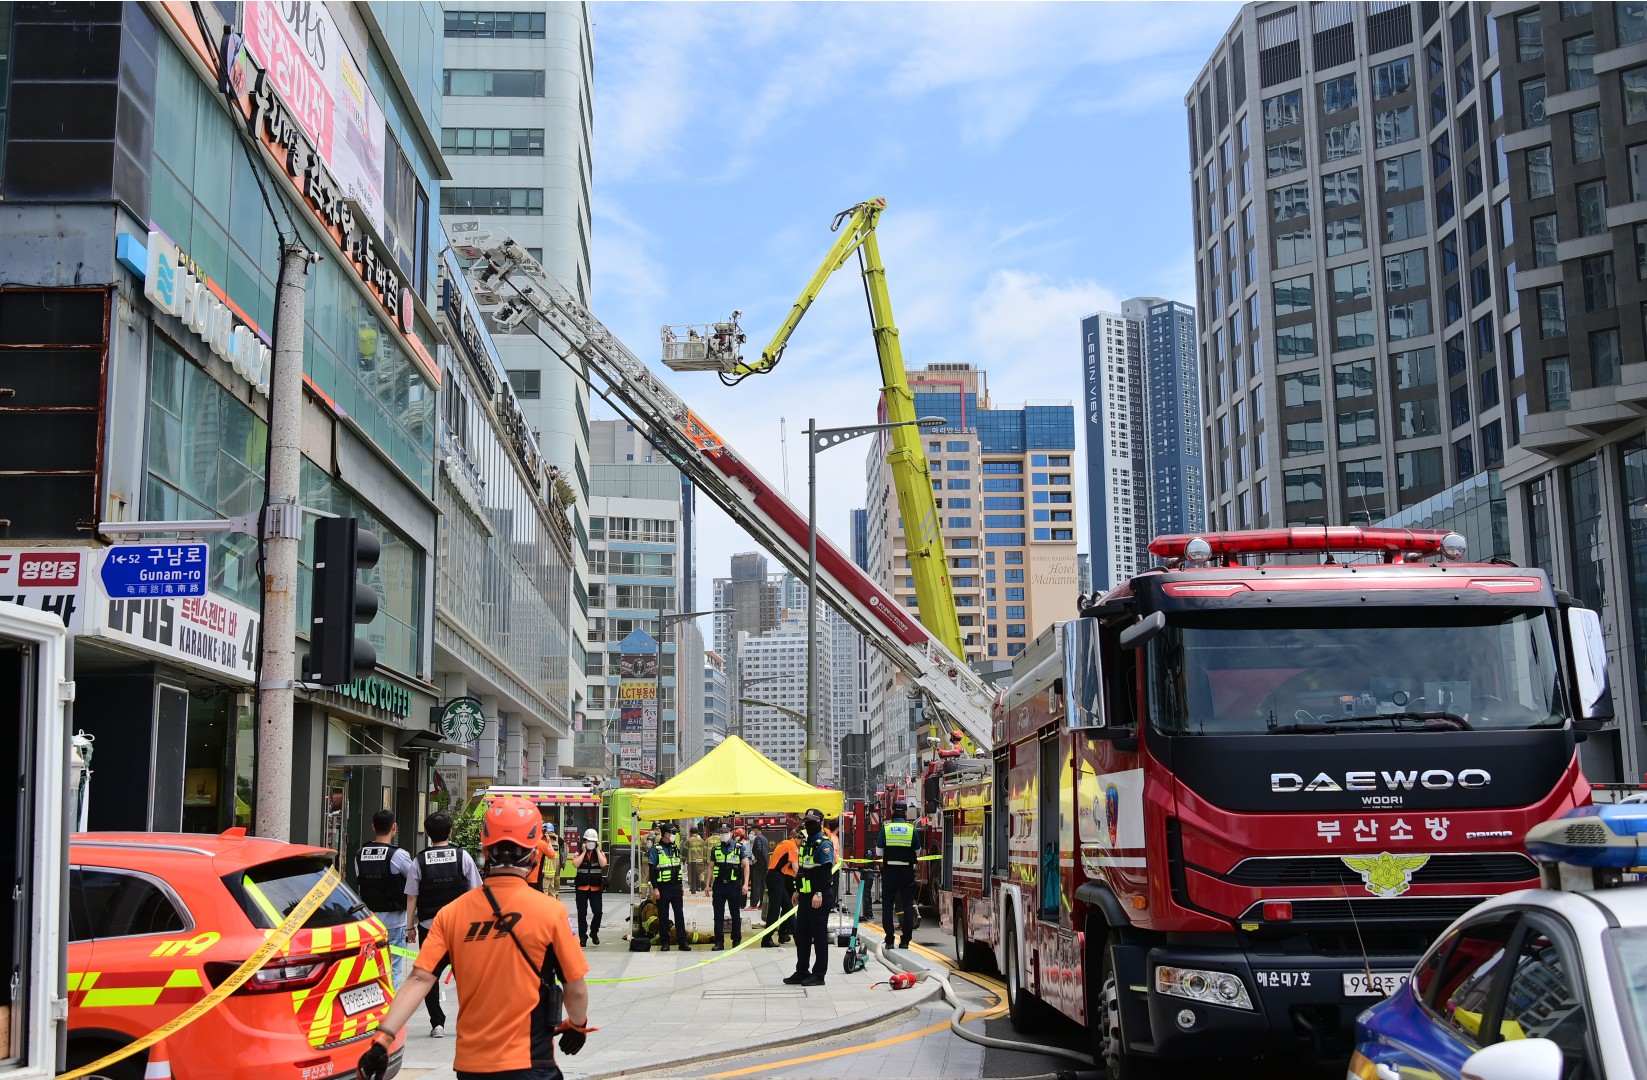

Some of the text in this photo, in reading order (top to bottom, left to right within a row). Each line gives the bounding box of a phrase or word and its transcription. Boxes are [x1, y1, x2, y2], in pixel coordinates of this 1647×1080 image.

[304, 153, 355, 251] 감자탕
[362, 234, 399, 316] 등뼈찜
[148, 547, 201, 566] 구남로
[22, 561, 77, 579] 영업중
[139, 569, 201, 581] Gunam-ro
[1048, 563, 1076, 574] Hotel
[228, 611, 237, 638] 바
[179, 625, 217, 663] KARAOKE
[221, 641, 237, 669] BAR
[380, 679, 412, 718] COFFEE
[1271, 769, 1492, 793] DAEWOO
[1361, 796, 1403, 804] WOORI
[1317, 817, 1451, 843] 부산소방
[1466, 831, 1513, 840] PRIMA
[463, 912, 522, 942] 119
[150, 932, 221, 957] 119
[1257, 971, 1312, 987] 해운대7호
[302, 1062, 334, 1080] 부산소방
